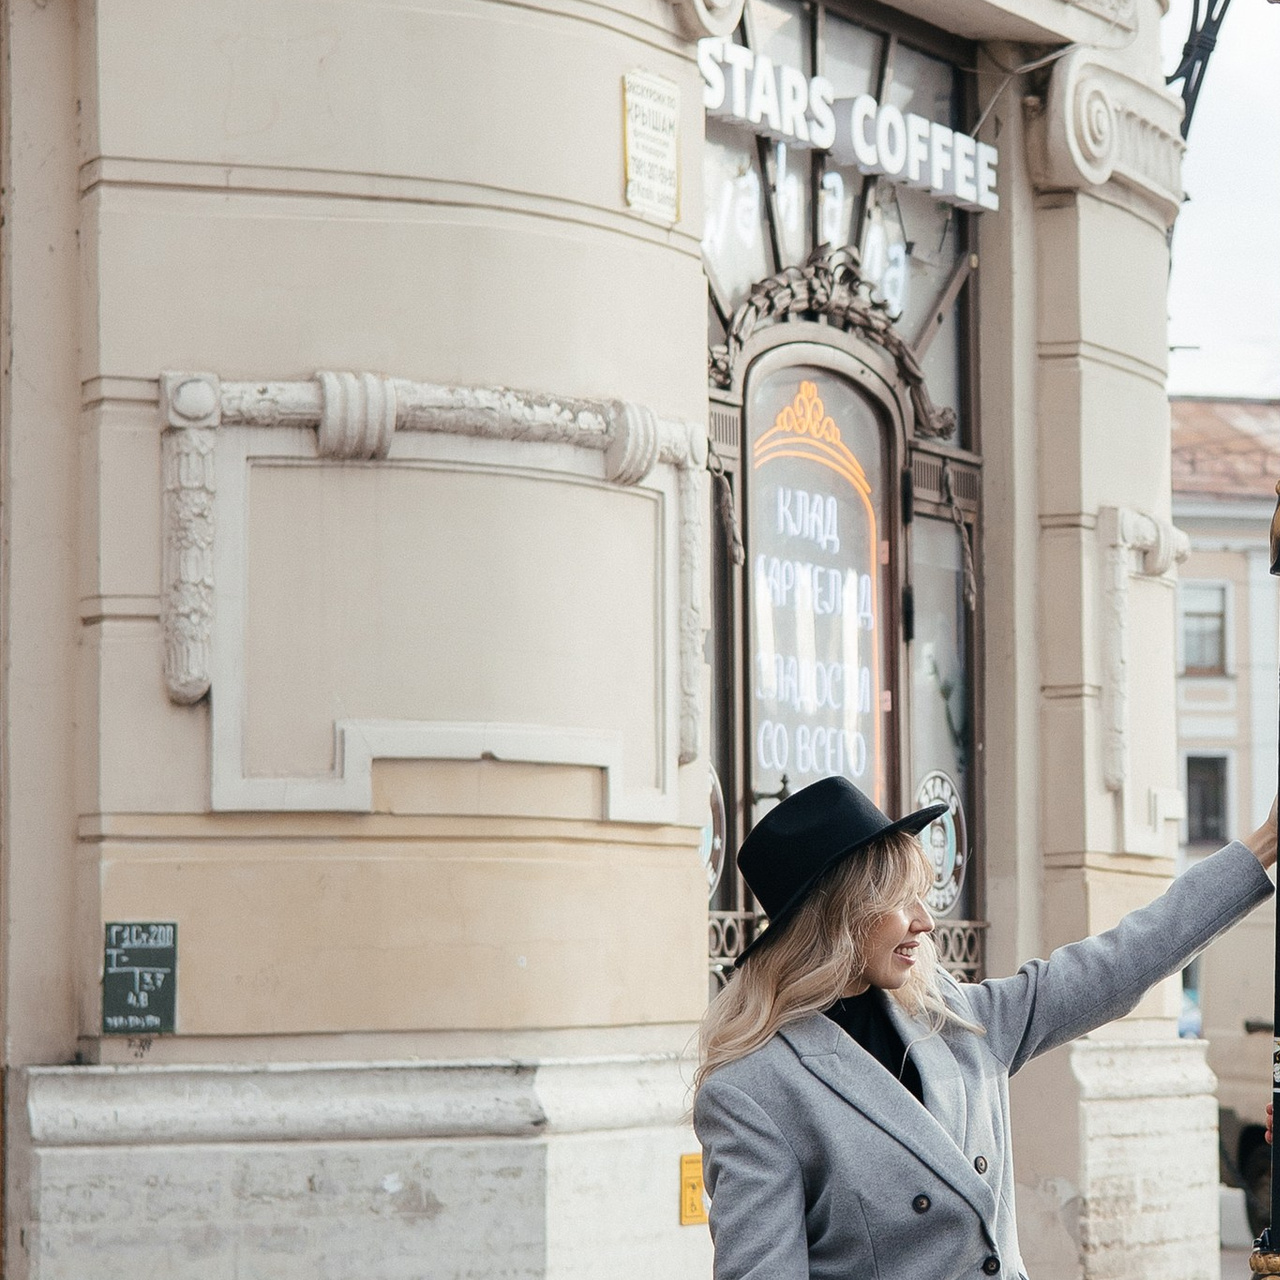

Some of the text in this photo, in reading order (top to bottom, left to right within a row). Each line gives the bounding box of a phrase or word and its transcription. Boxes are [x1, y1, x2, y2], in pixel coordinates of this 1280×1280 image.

[698, 36, 999, 211] STARS COFFEE
[777, 486, 840, 555] КЛАД
[755, 554, 874, 631] АРМЕЛД
[756, 652, 871, 716] ЛАДОСИ
[757, 719, 867, 777] СО ВСЕГО
